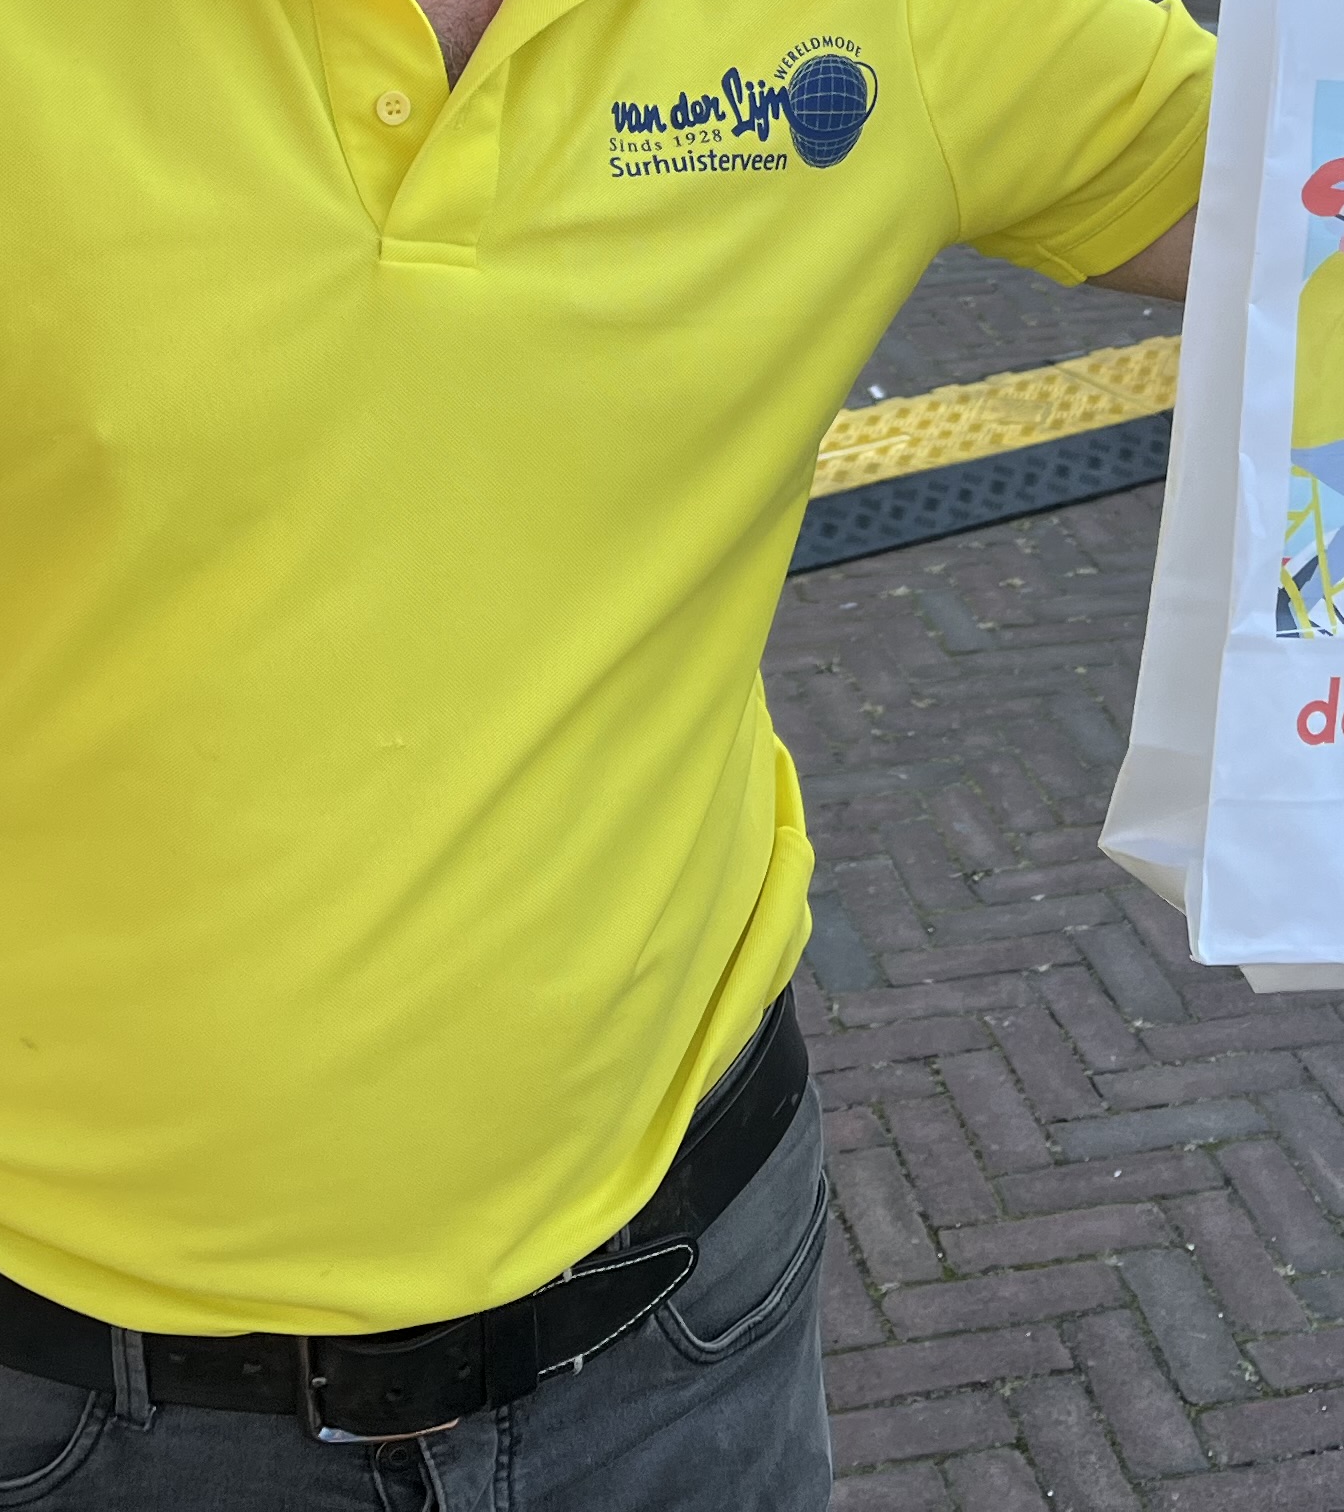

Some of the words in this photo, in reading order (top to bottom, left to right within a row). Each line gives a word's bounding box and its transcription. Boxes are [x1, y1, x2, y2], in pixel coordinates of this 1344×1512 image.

[774, 35, 862, 81] WERELDMODE
[611, 98, 667, 134] van
[670, 91, 726, 132] der
[721, 67, 792, 142] Lijn
[609, 137, 663, 153] Sinds
[673, 129, 723, 148] 1928
[609, 150, 788, 178] Surhuisterveen
